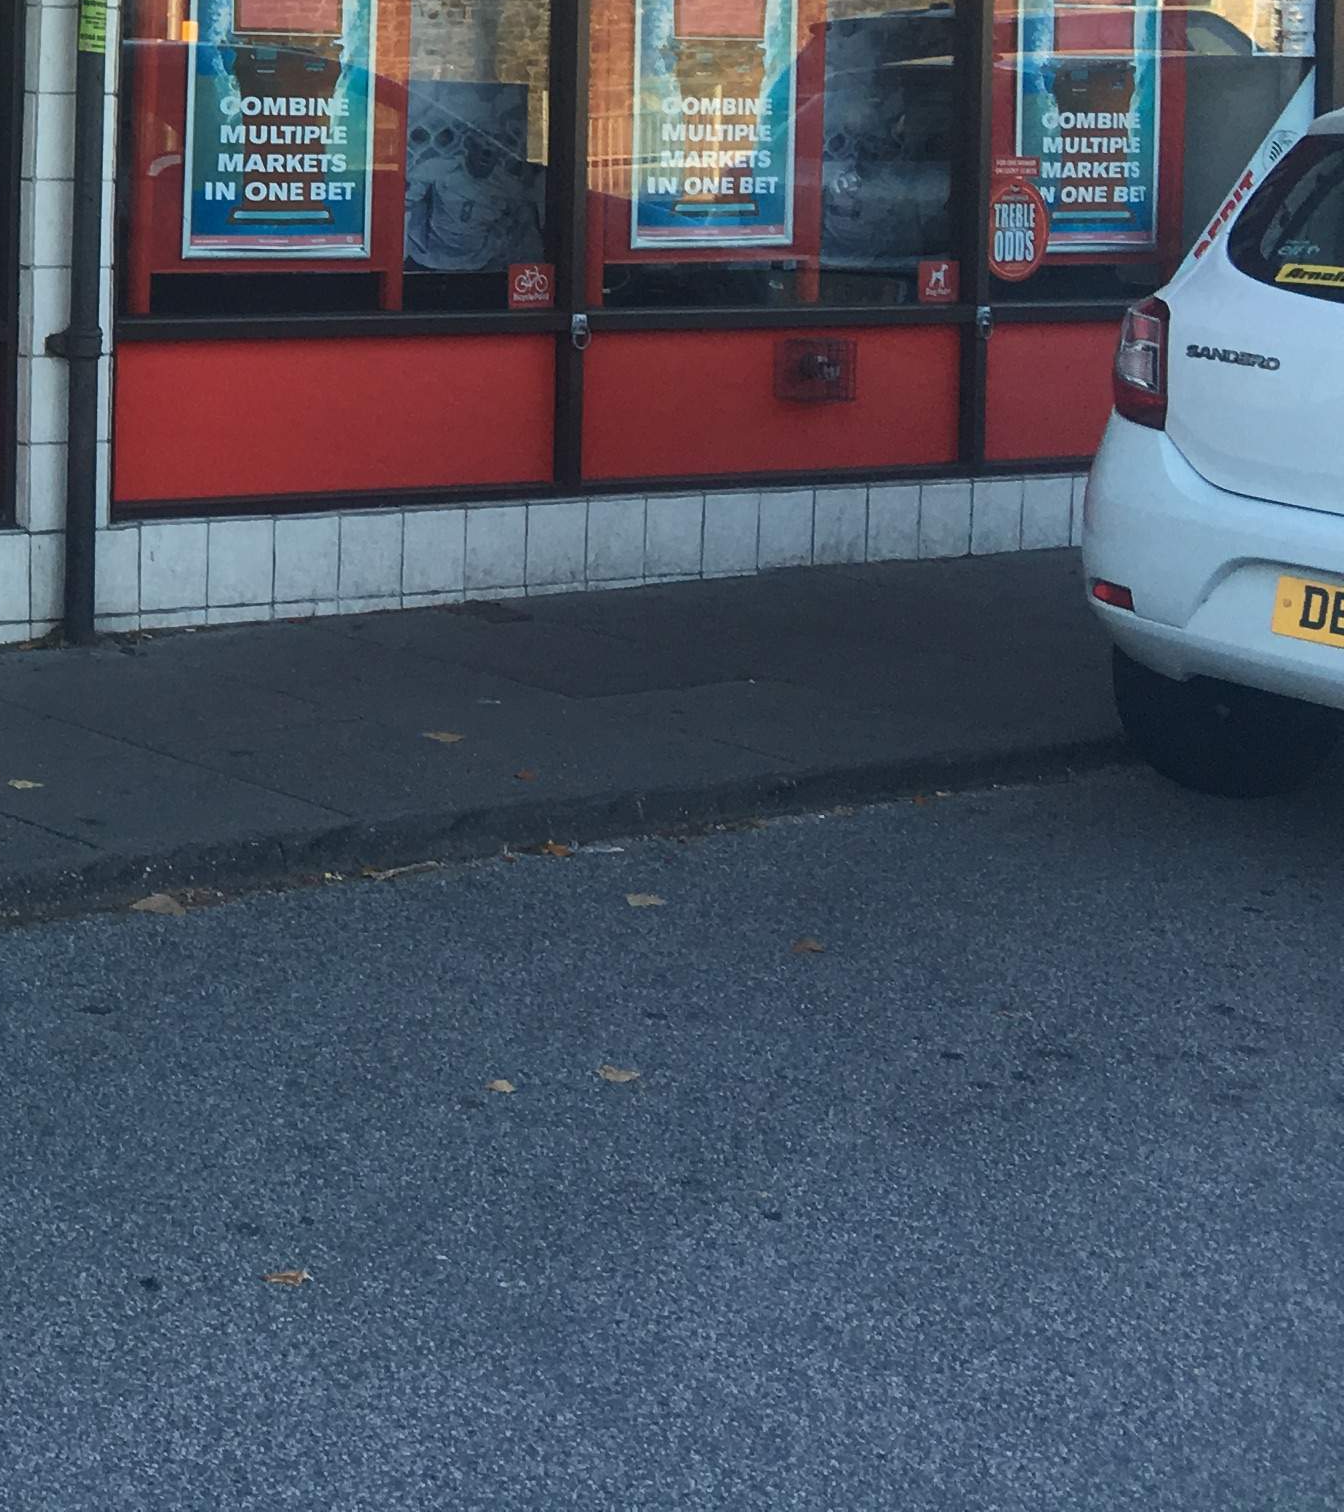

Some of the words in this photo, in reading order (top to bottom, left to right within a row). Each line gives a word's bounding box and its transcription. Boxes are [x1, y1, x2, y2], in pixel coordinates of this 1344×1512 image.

[219, 96, 349, 116] COMBINE
[662, 97, 773, 116] COMBINE
[1042, 112, 1140, 129] COMBINE
[220, 125, 348, 144] MULTIPLE
[662, 124, 772, 141] MULTIPLE
[1042, 137, 1140, 154] MULTIPLE
[218, 153, 347, 173] MARKETS
[660, 150, 772, 168] MARKETS
[1041, 162, 1140, 179] MARKETS
[204, 181, 236, 200] IN
[245, 182, 304, 201] ONE
[310, 182, 356, 201] BET
[647, 176, 677, 194] IN
[684, 177, 735, 195] ONE
[739, 177, 779, 194] BET
[1039, 187, 1054, 203] N
[1061, 186, 1107, 203] ONE
[1113, 186, 1146, 202] BET
[994, 203, 1036, 228] TREBLE
[994, 230, 1034, 262] ODDS
[1186, 344, 1280, 372] SANDERO
